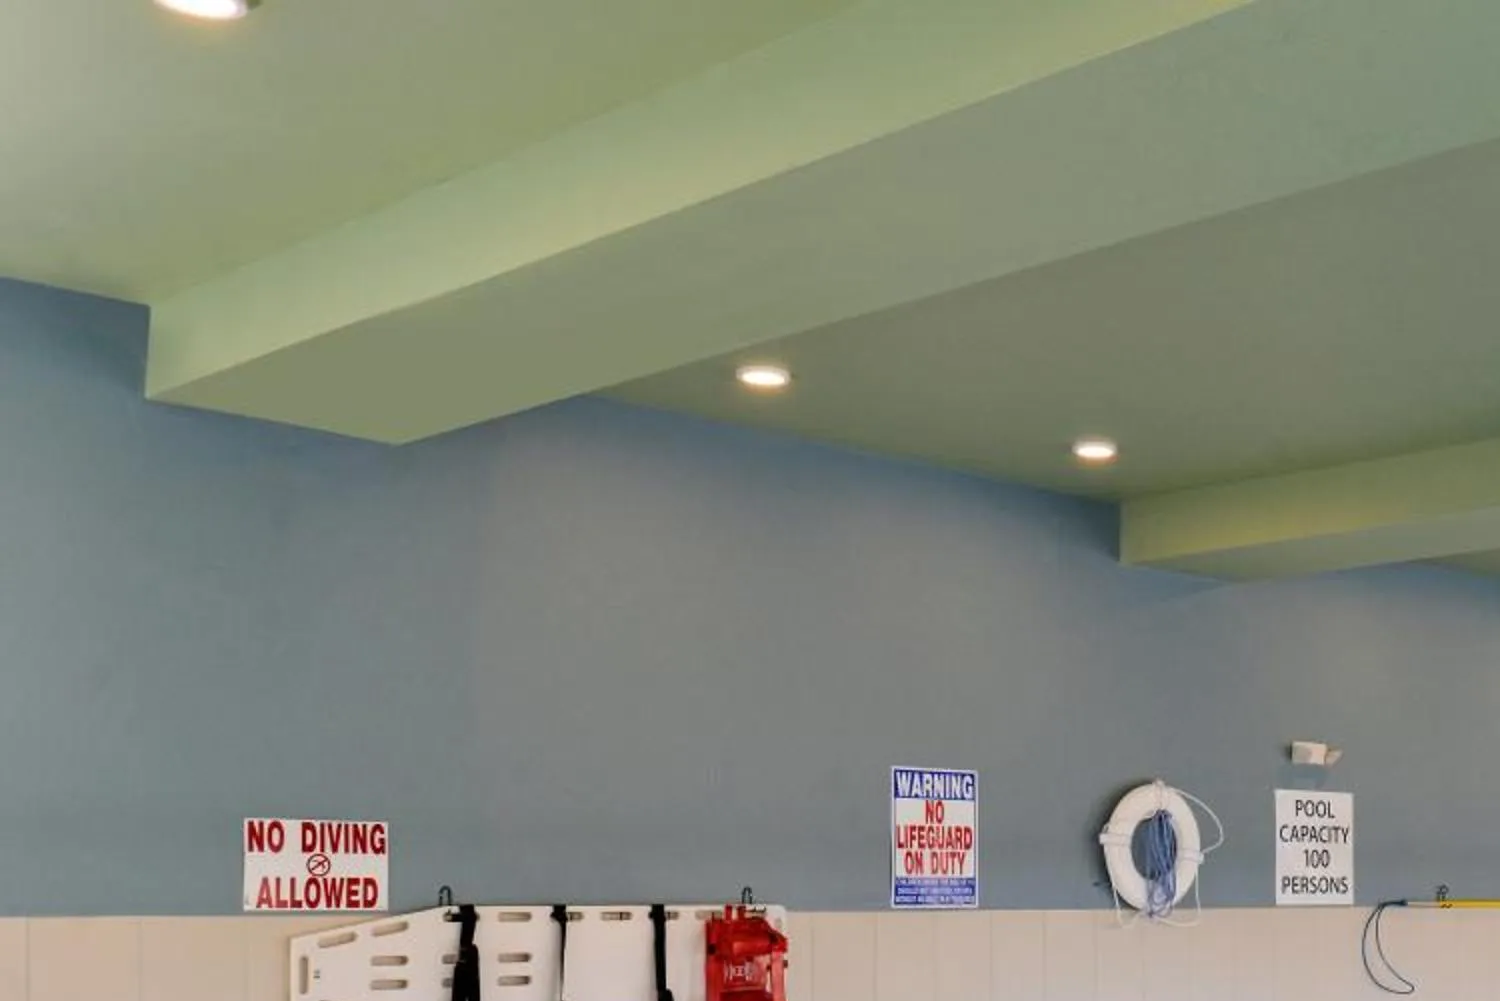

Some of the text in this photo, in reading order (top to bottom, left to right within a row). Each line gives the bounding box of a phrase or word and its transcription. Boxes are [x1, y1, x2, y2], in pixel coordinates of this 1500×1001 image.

[896, 771, 974, 799] WARNING
[925, 800, 944, 824] NO
[1295, 799, 1336, 819] POOL
[247, 820, 386, 855] NO DIVING
[896, 825, 974, 850] LIFEGUARD
[1279, 824, 1350, 844] CAPACITY
[904, 851, 967, 875] ON DUTY
[1303, 849, 1330, 869] 100
[255, 876, 379, 909] ALLOWED
[1281, 875, 1349, 895] PERSONS
